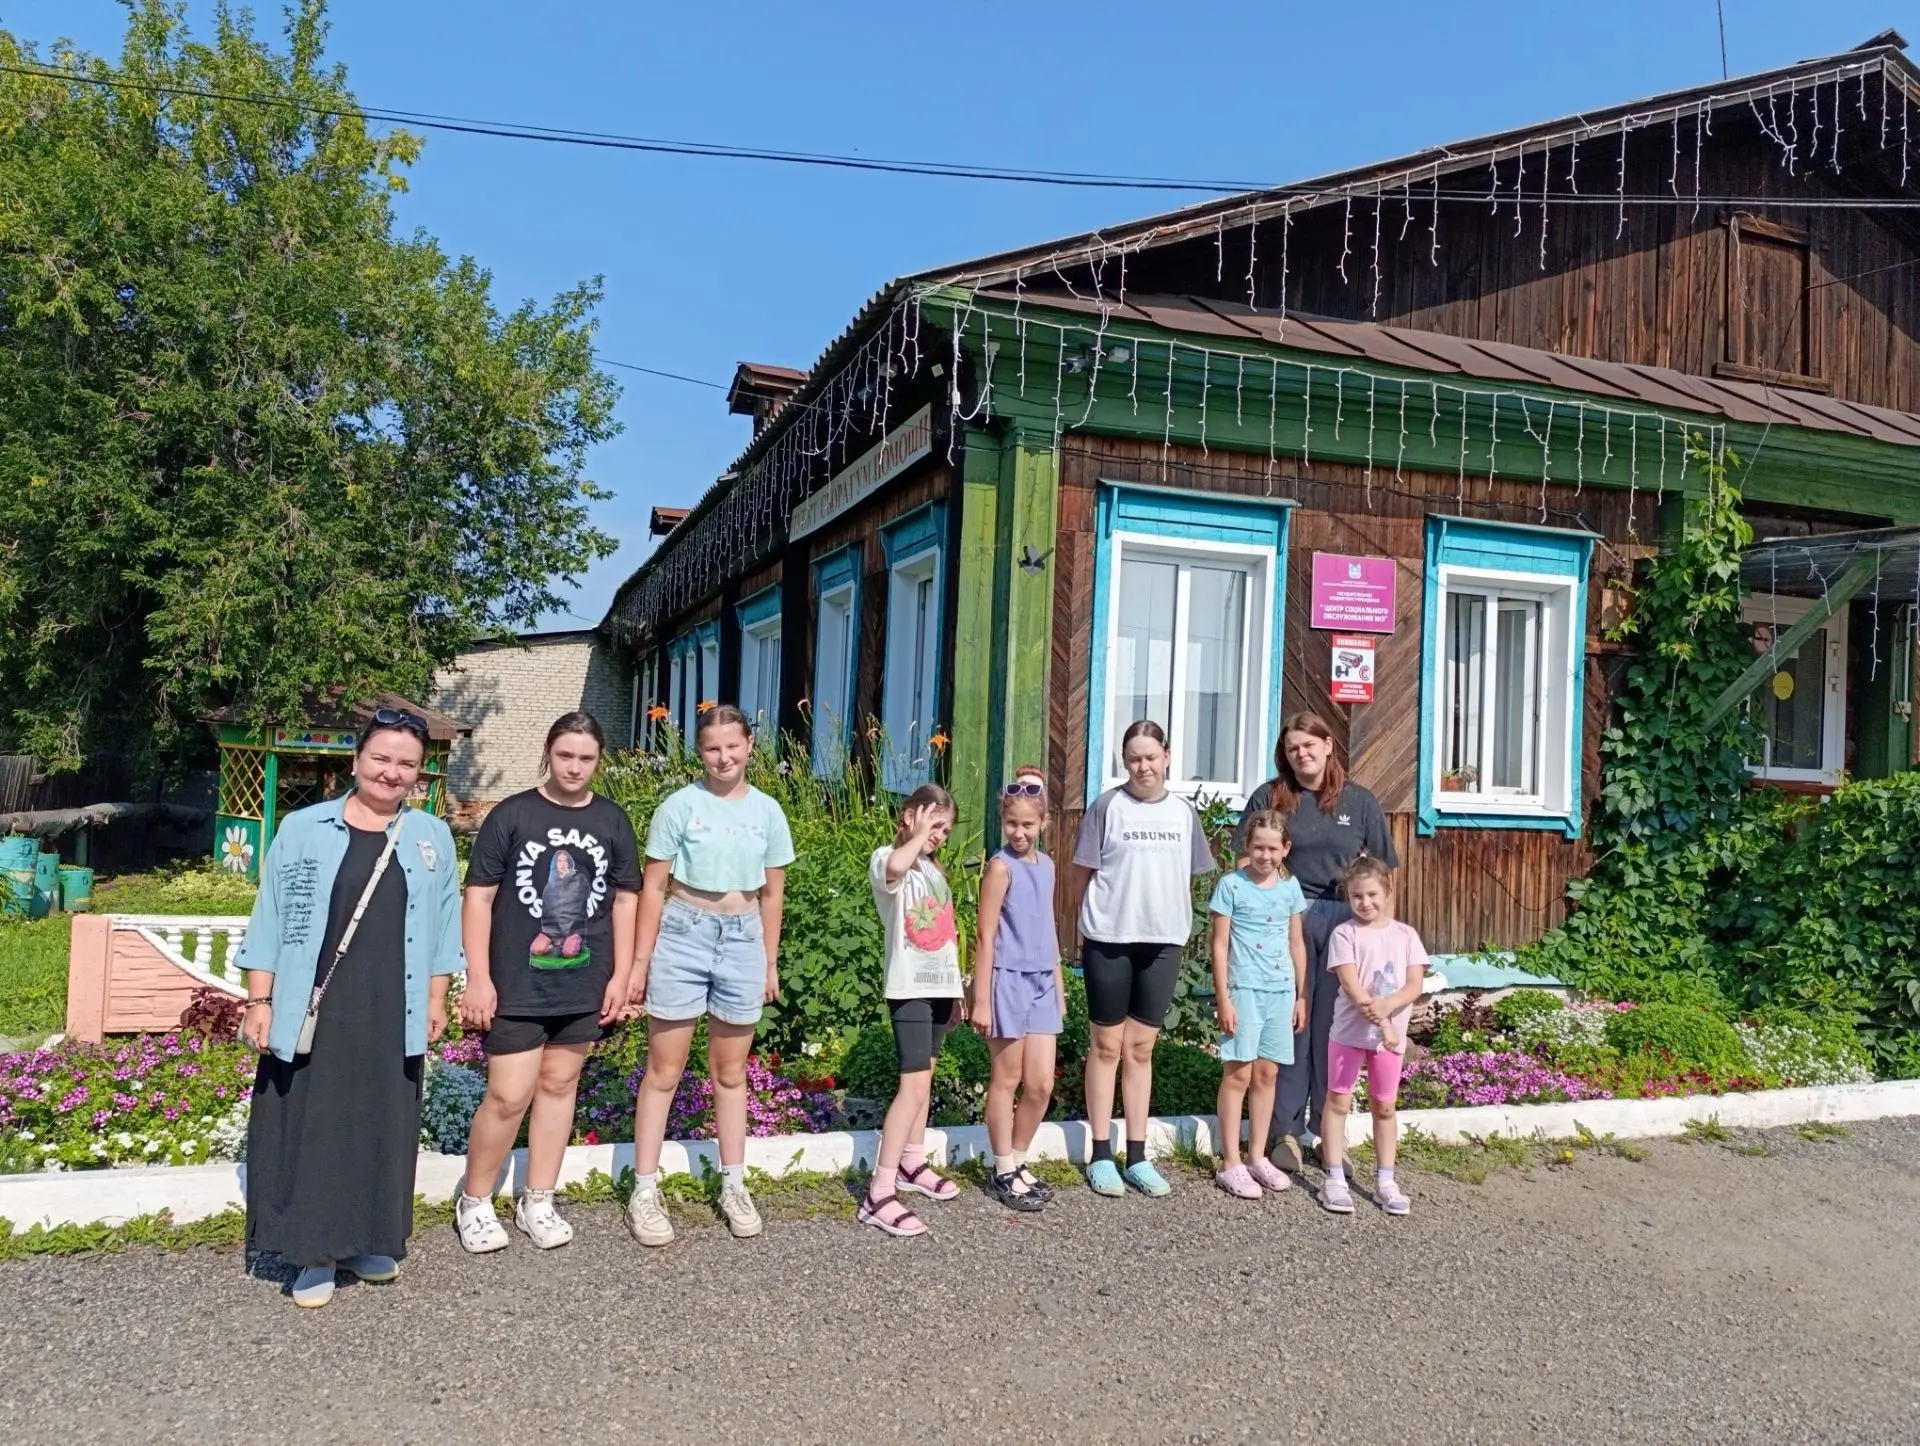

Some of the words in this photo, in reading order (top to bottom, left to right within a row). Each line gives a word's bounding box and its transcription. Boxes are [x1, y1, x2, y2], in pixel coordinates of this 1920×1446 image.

[874, 413, 929, 482] ПОМОЩИ
[1345, 606, 1388, 615] СОЦИАЛЬНОГО
[1323, 613, 1374, 622] ОБСЛУЖИВАНИЯ
[1123, 831, 1181, 842] SSBUNNY
[516, 840, 547, 918] SONYA
